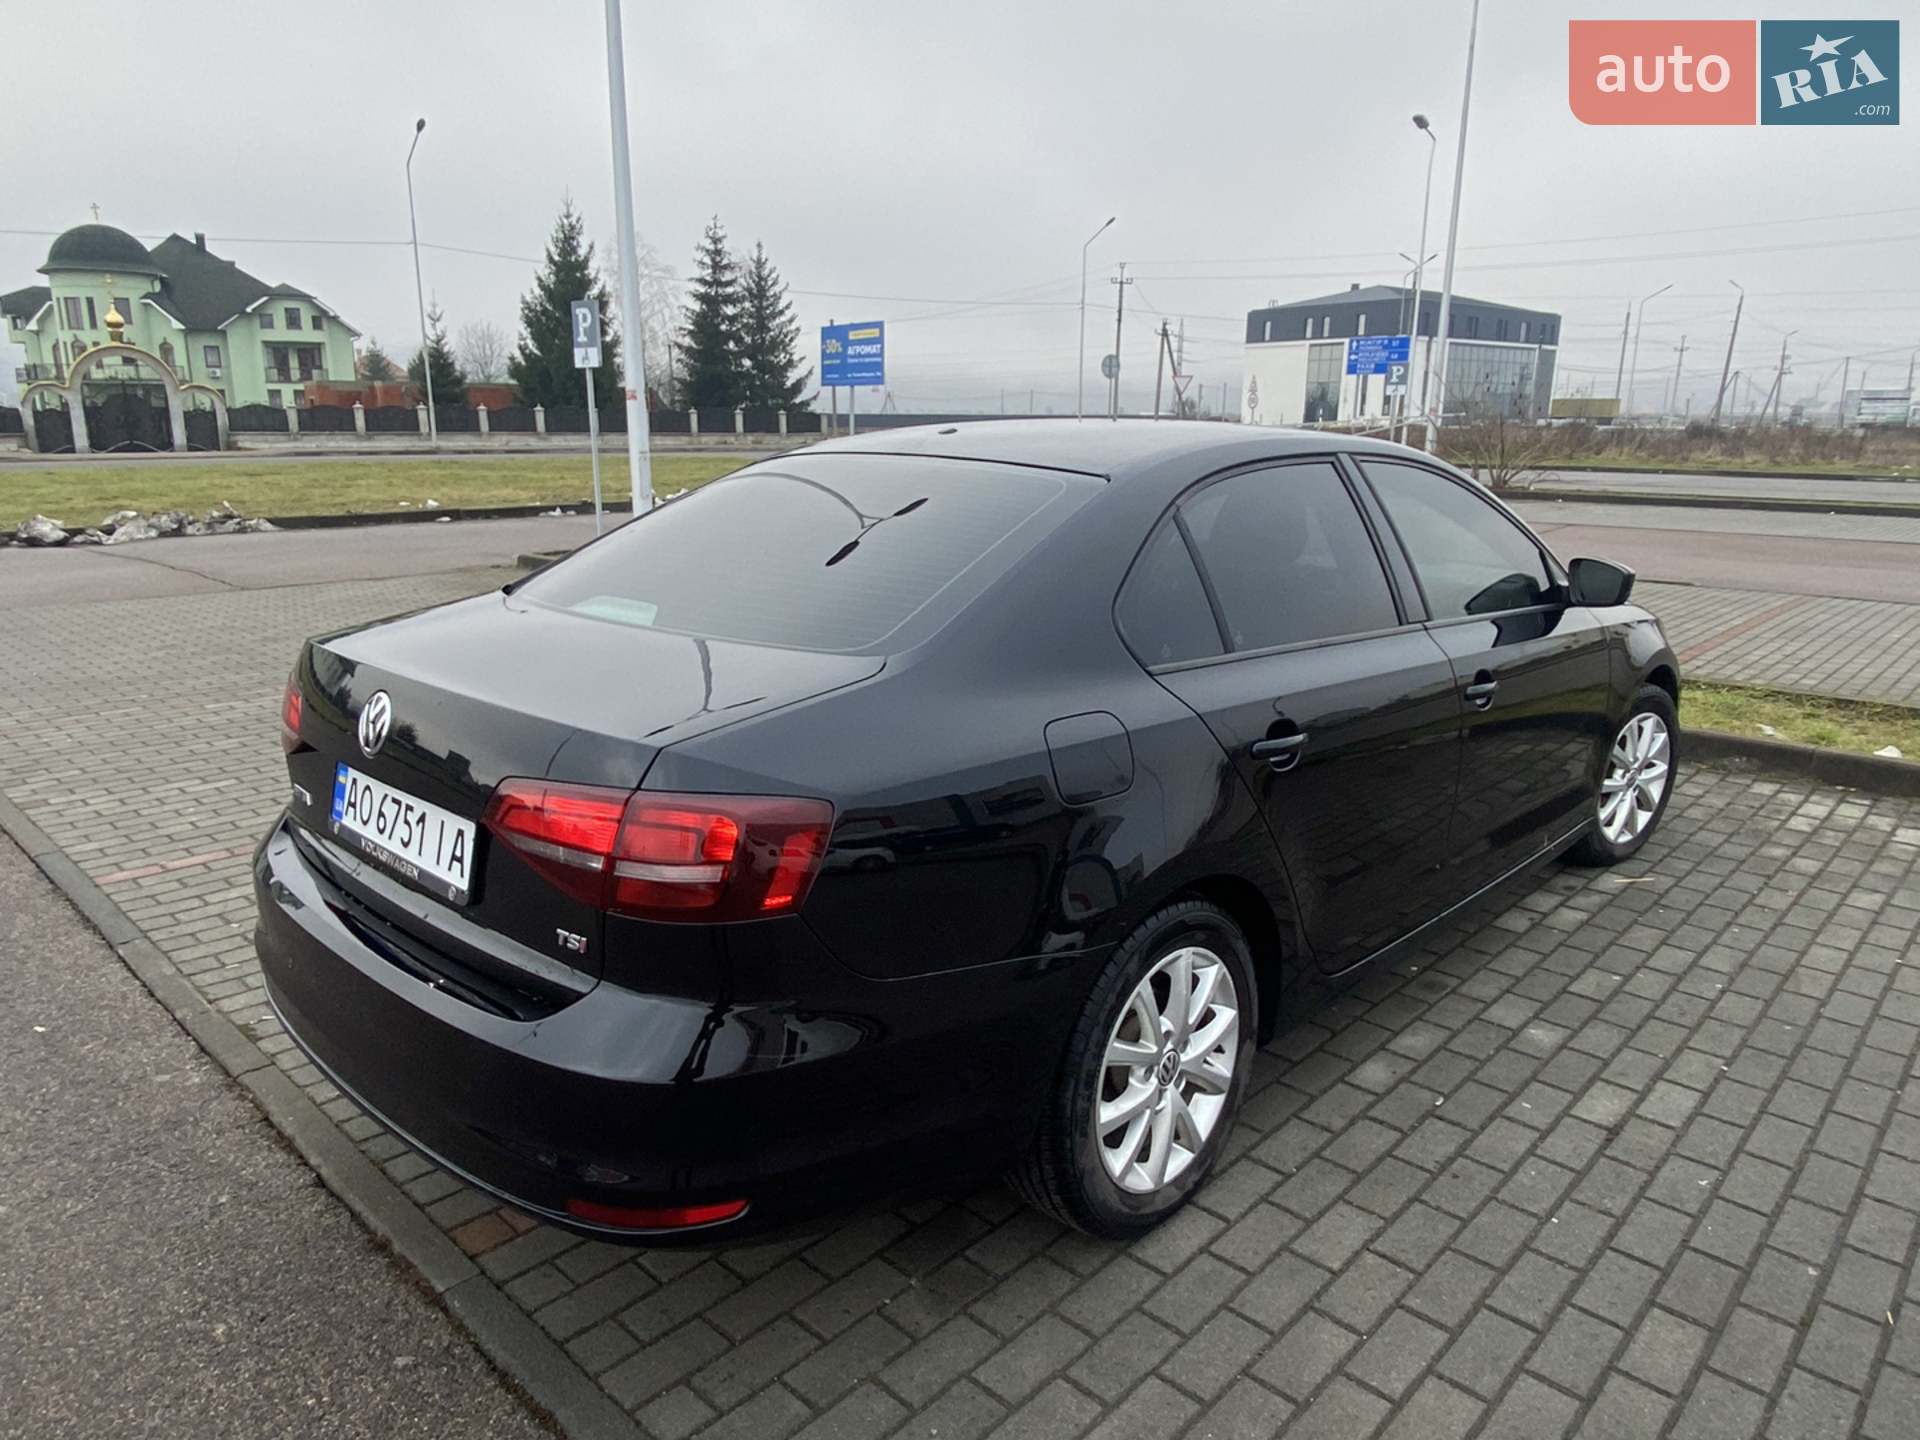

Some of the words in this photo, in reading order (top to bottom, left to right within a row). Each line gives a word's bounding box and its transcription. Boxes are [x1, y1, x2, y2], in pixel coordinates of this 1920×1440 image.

[575, 307, 592, 342] P
[1390, 365, 1404, 383] P
[345, 777, 373, 827] AO
[376, 792, 427, 857] 6751
[436, 819, 465, 879] IA
[360, 837, 420, 881] VOLKSWAGEN
